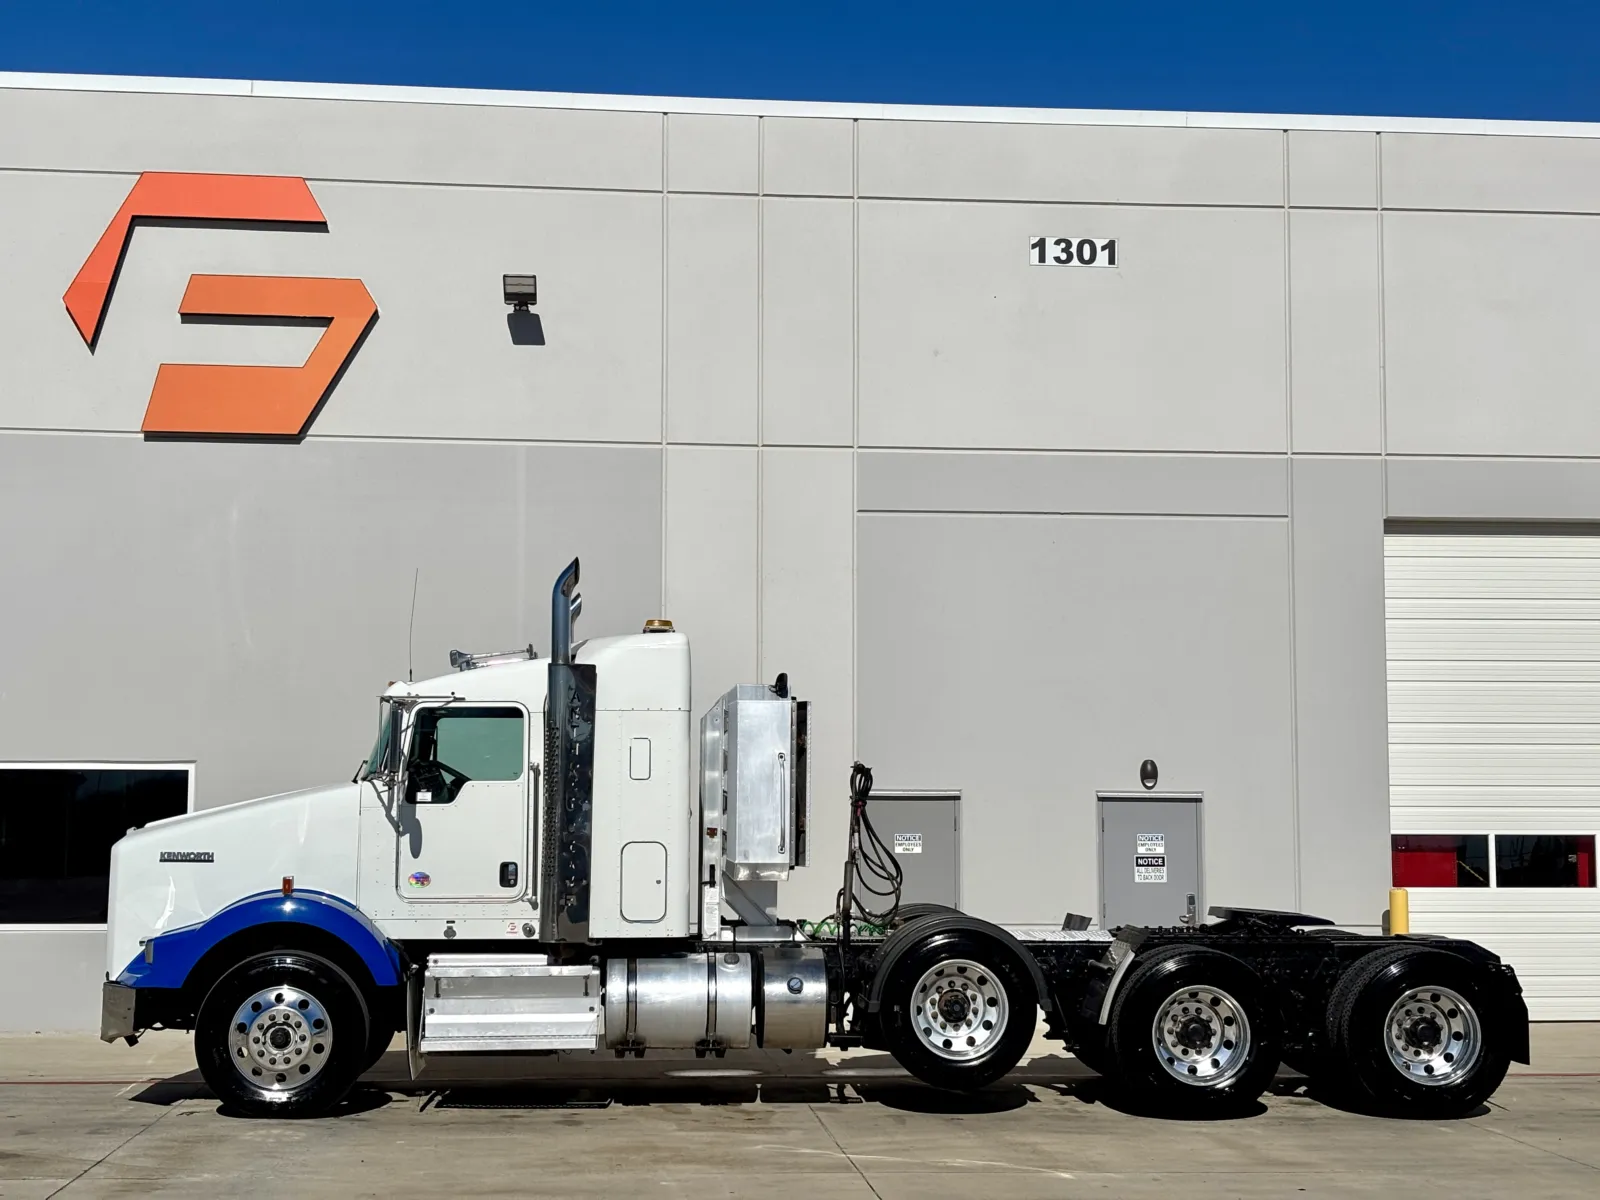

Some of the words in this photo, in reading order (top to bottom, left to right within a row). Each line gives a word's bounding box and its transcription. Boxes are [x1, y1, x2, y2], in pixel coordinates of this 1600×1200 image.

[1031, 237, 1116, 266] 1301
[160, 851, 215, 863] KENWORTH
[1137, 858, 1164, 866] NOTICE
